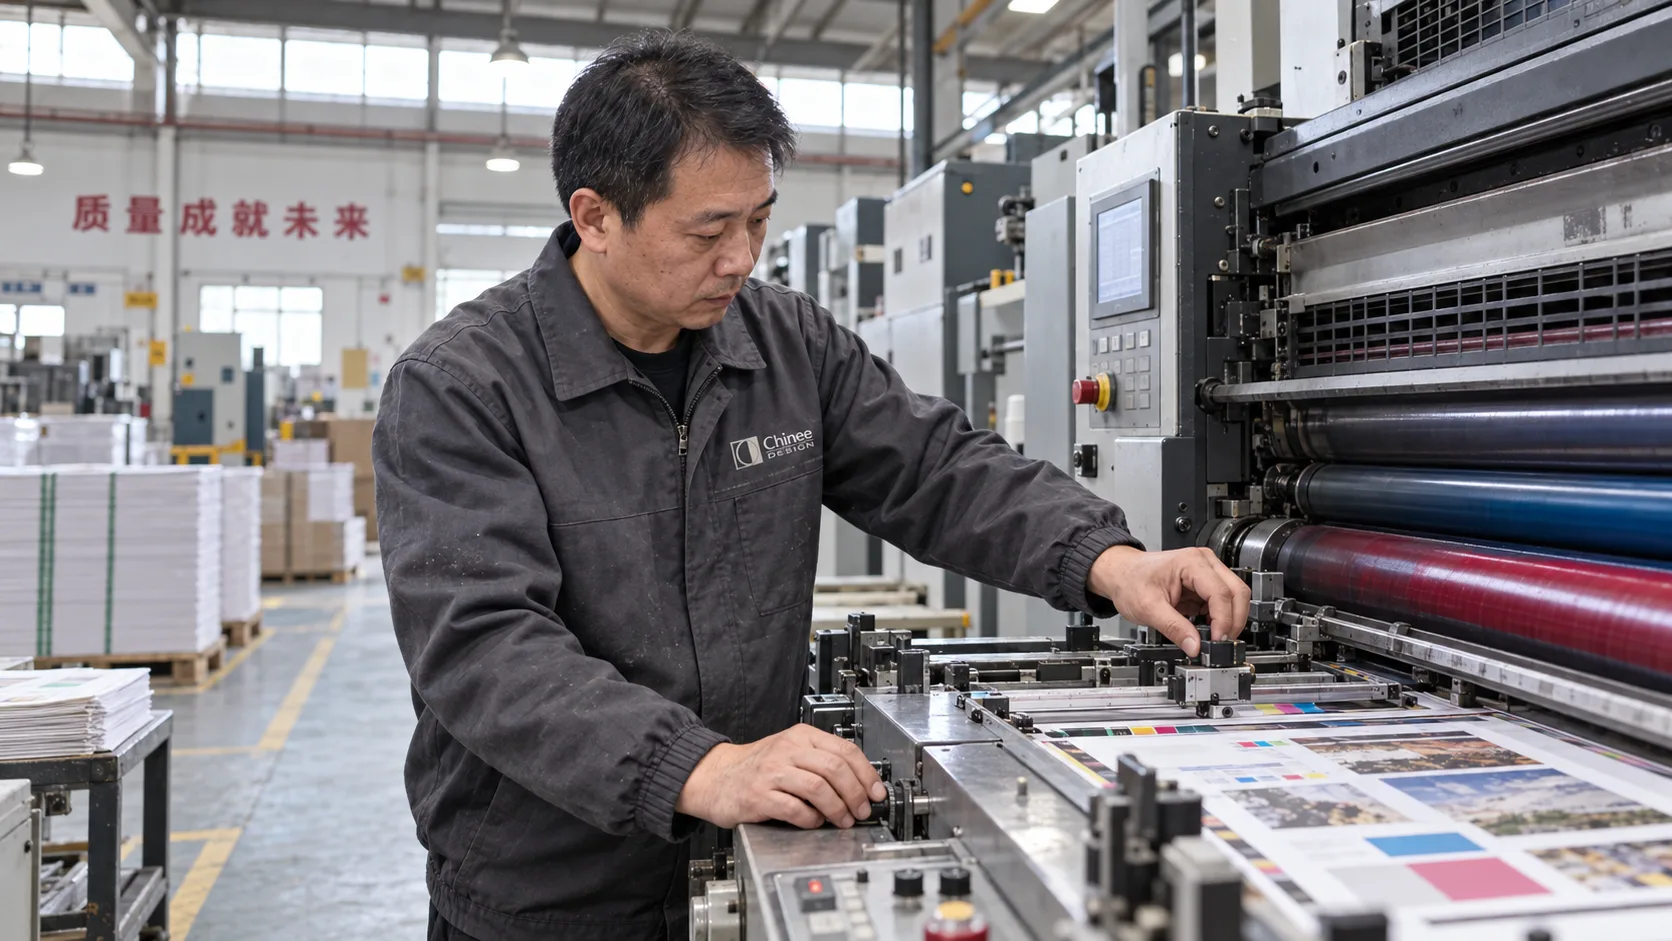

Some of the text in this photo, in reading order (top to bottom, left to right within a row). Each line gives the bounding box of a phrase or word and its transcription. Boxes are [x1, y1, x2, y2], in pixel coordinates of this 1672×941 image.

[72, 194, 370, 240] 质量成就未来
[763, 429, 813, 450] Chinee
